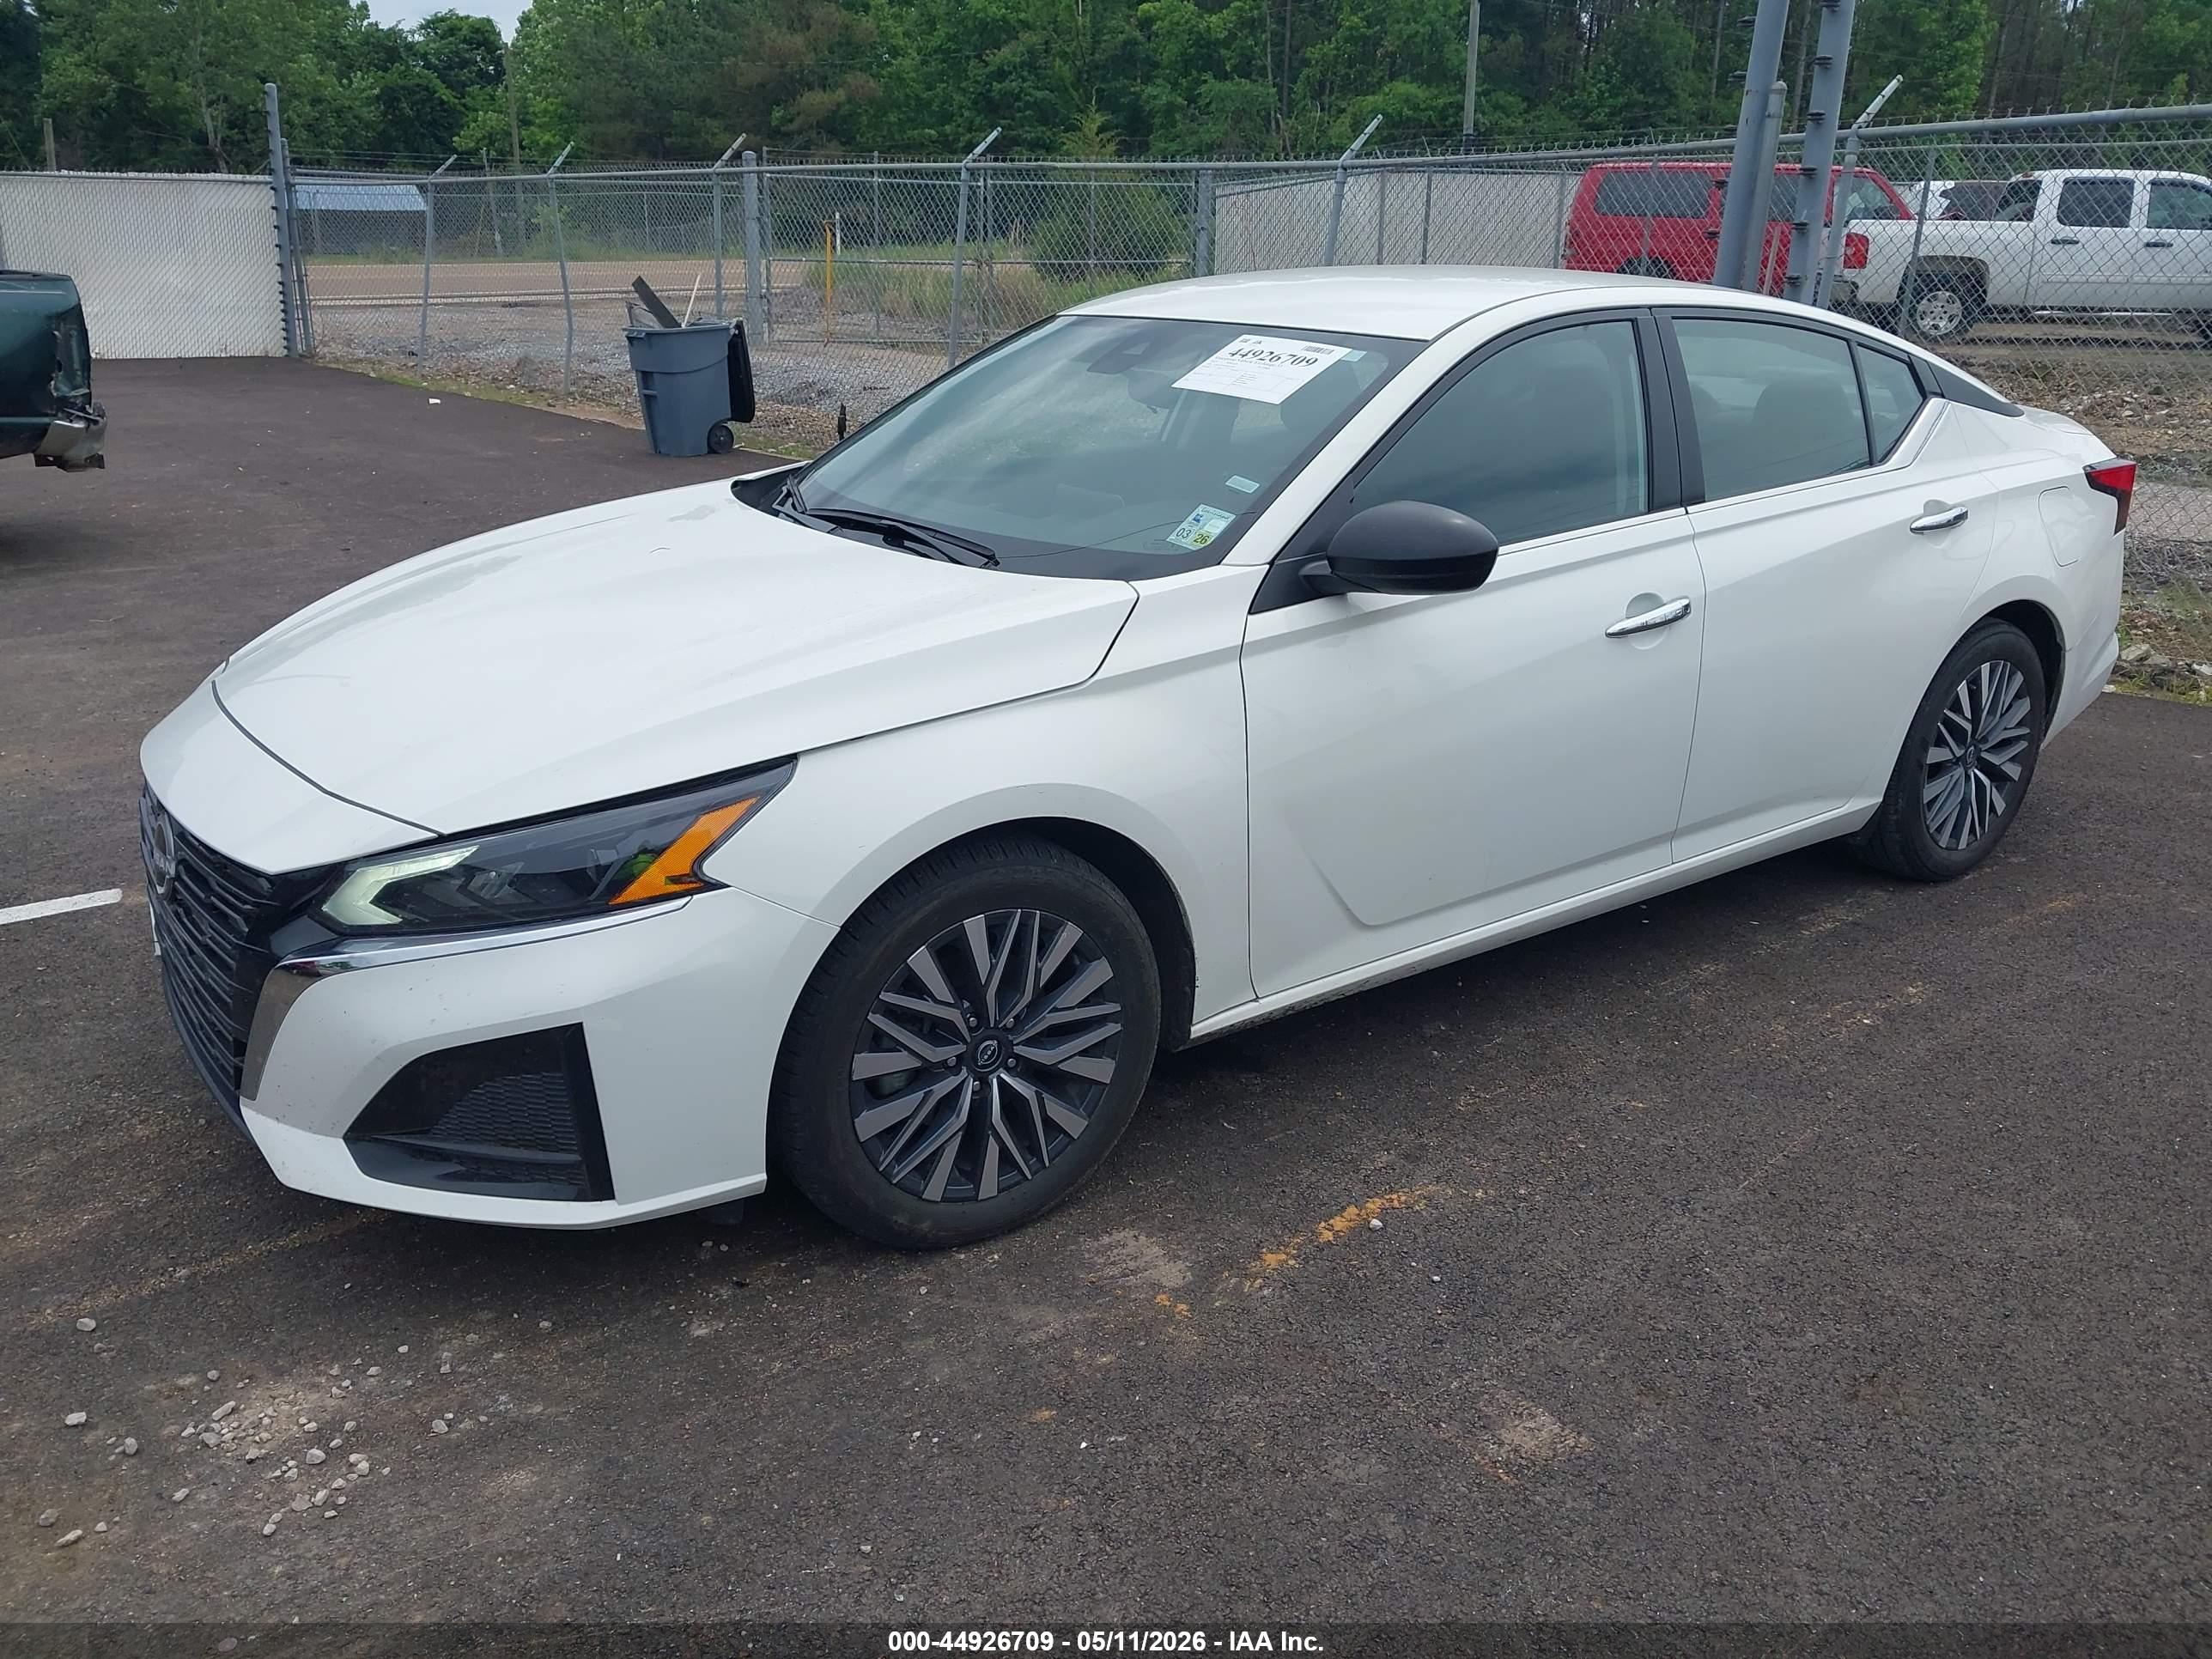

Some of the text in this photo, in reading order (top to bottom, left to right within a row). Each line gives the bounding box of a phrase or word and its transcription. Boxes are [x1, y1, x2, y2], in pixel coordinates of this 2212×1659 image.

[1228, 347, 1319, 368] 44926709
[1176, 527, 1210, 545] 03 26
